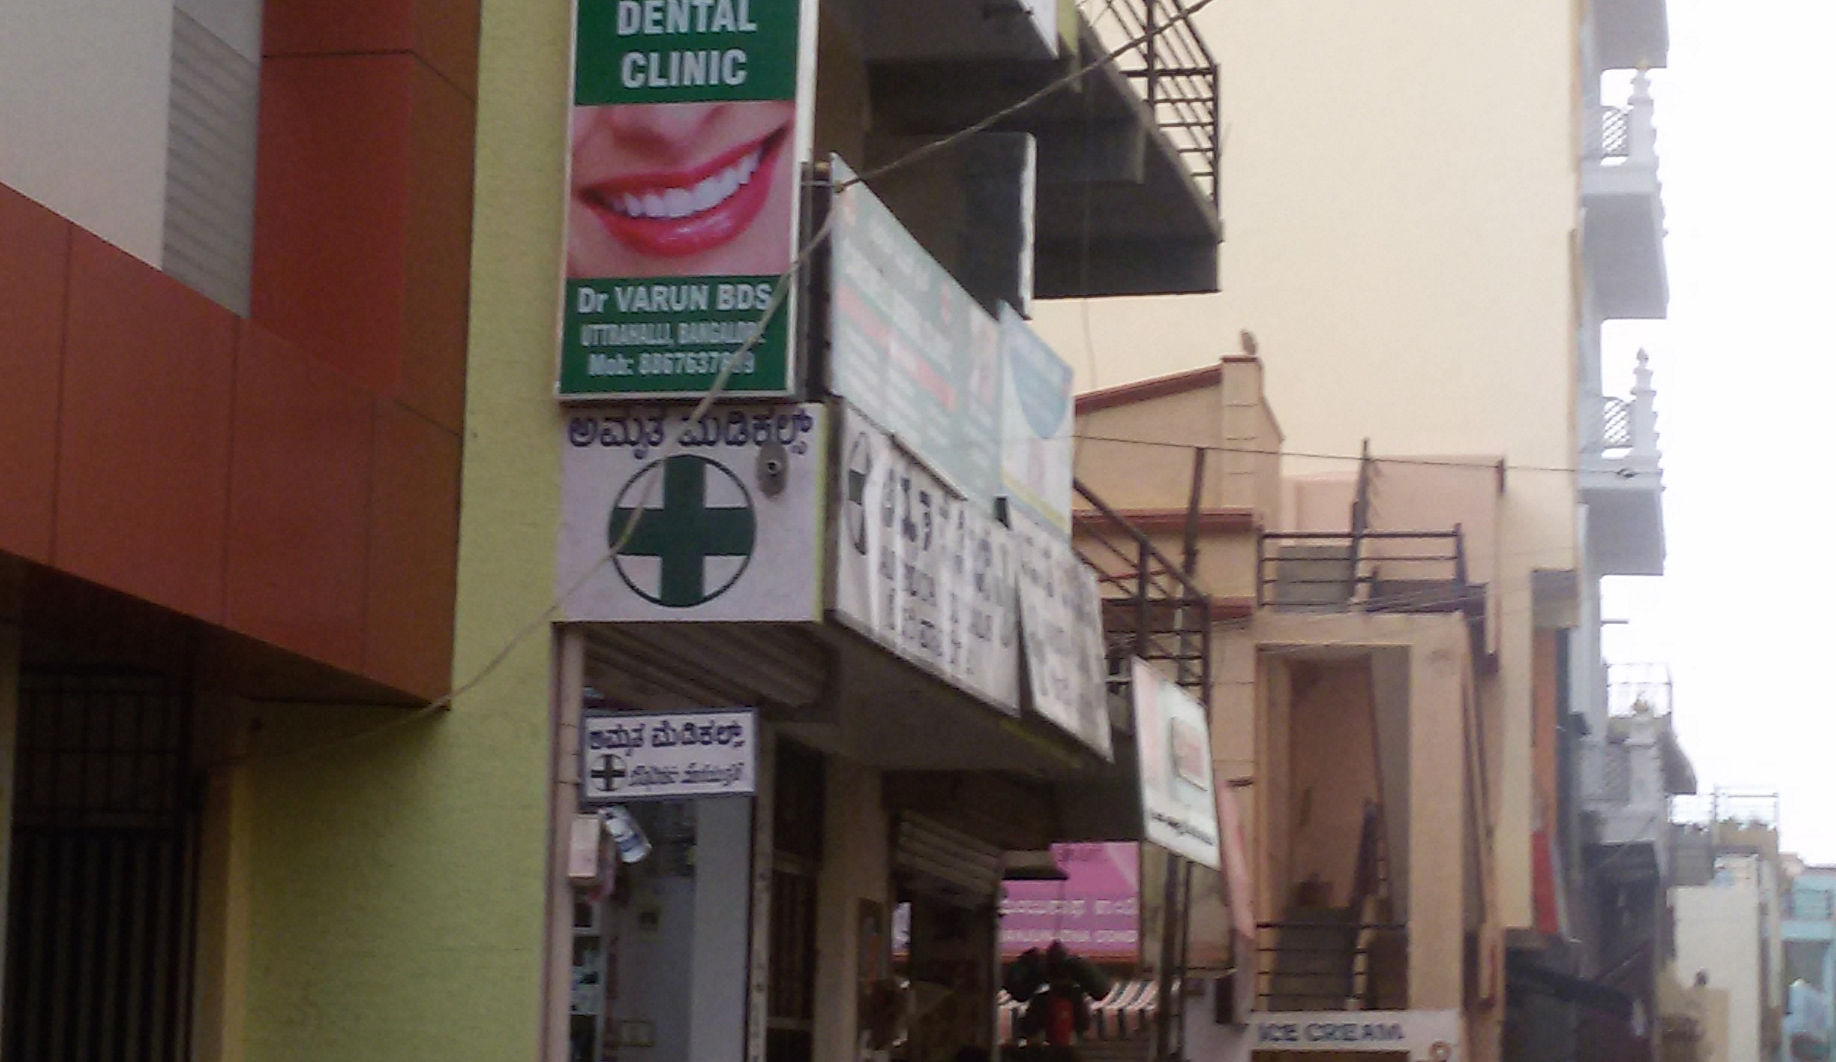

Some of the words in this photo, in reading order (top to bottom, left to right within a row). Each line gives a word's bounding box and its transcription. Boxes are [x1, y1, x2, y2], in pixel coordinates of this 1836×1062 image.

[621, 49, 747, 88] CLINIC
[577, 287, 608, 313] Dr
[614, 285, 709, 313] VARUN
[716, 283, 773, 311] BDS
